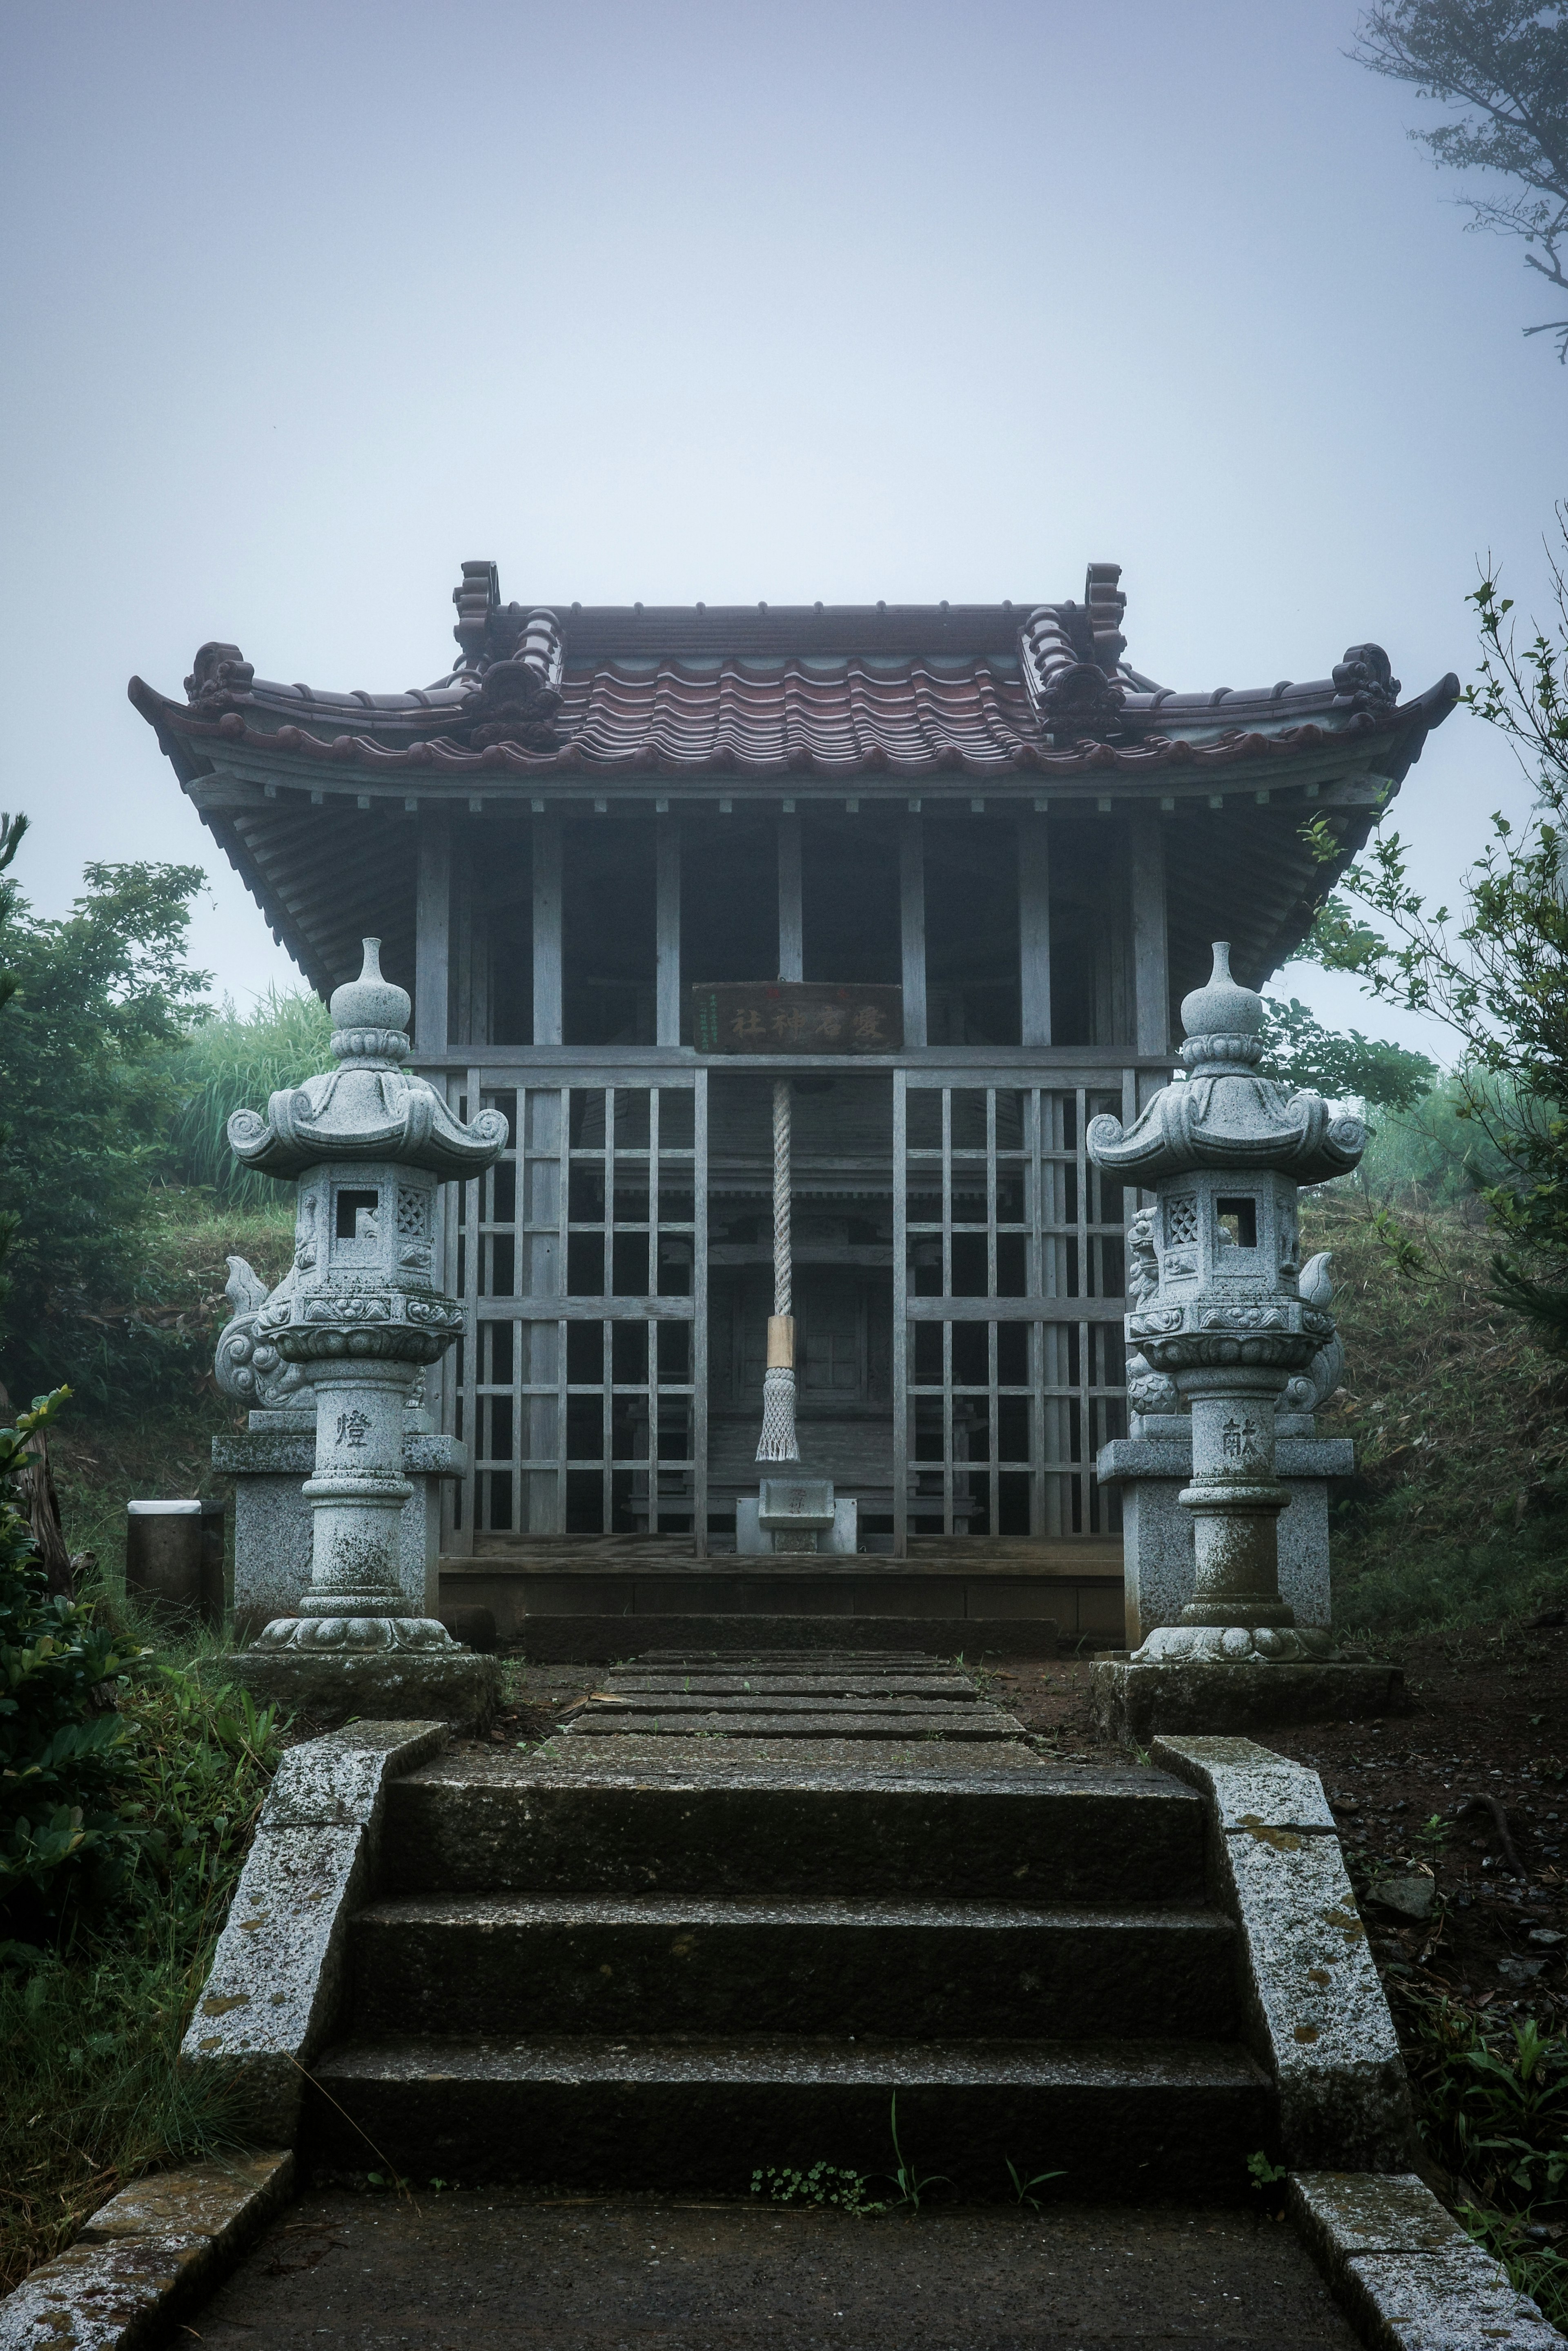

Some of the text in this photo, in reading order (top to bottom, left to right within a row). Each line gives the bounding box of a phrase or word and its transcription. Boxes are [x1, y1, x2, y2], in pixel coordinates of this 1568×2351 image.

[731, 1006, 886, 1041] 愛宕神社
[336, 1410, 372, 1447] 燈
[1222, 1418, 1259, 1458] 献
